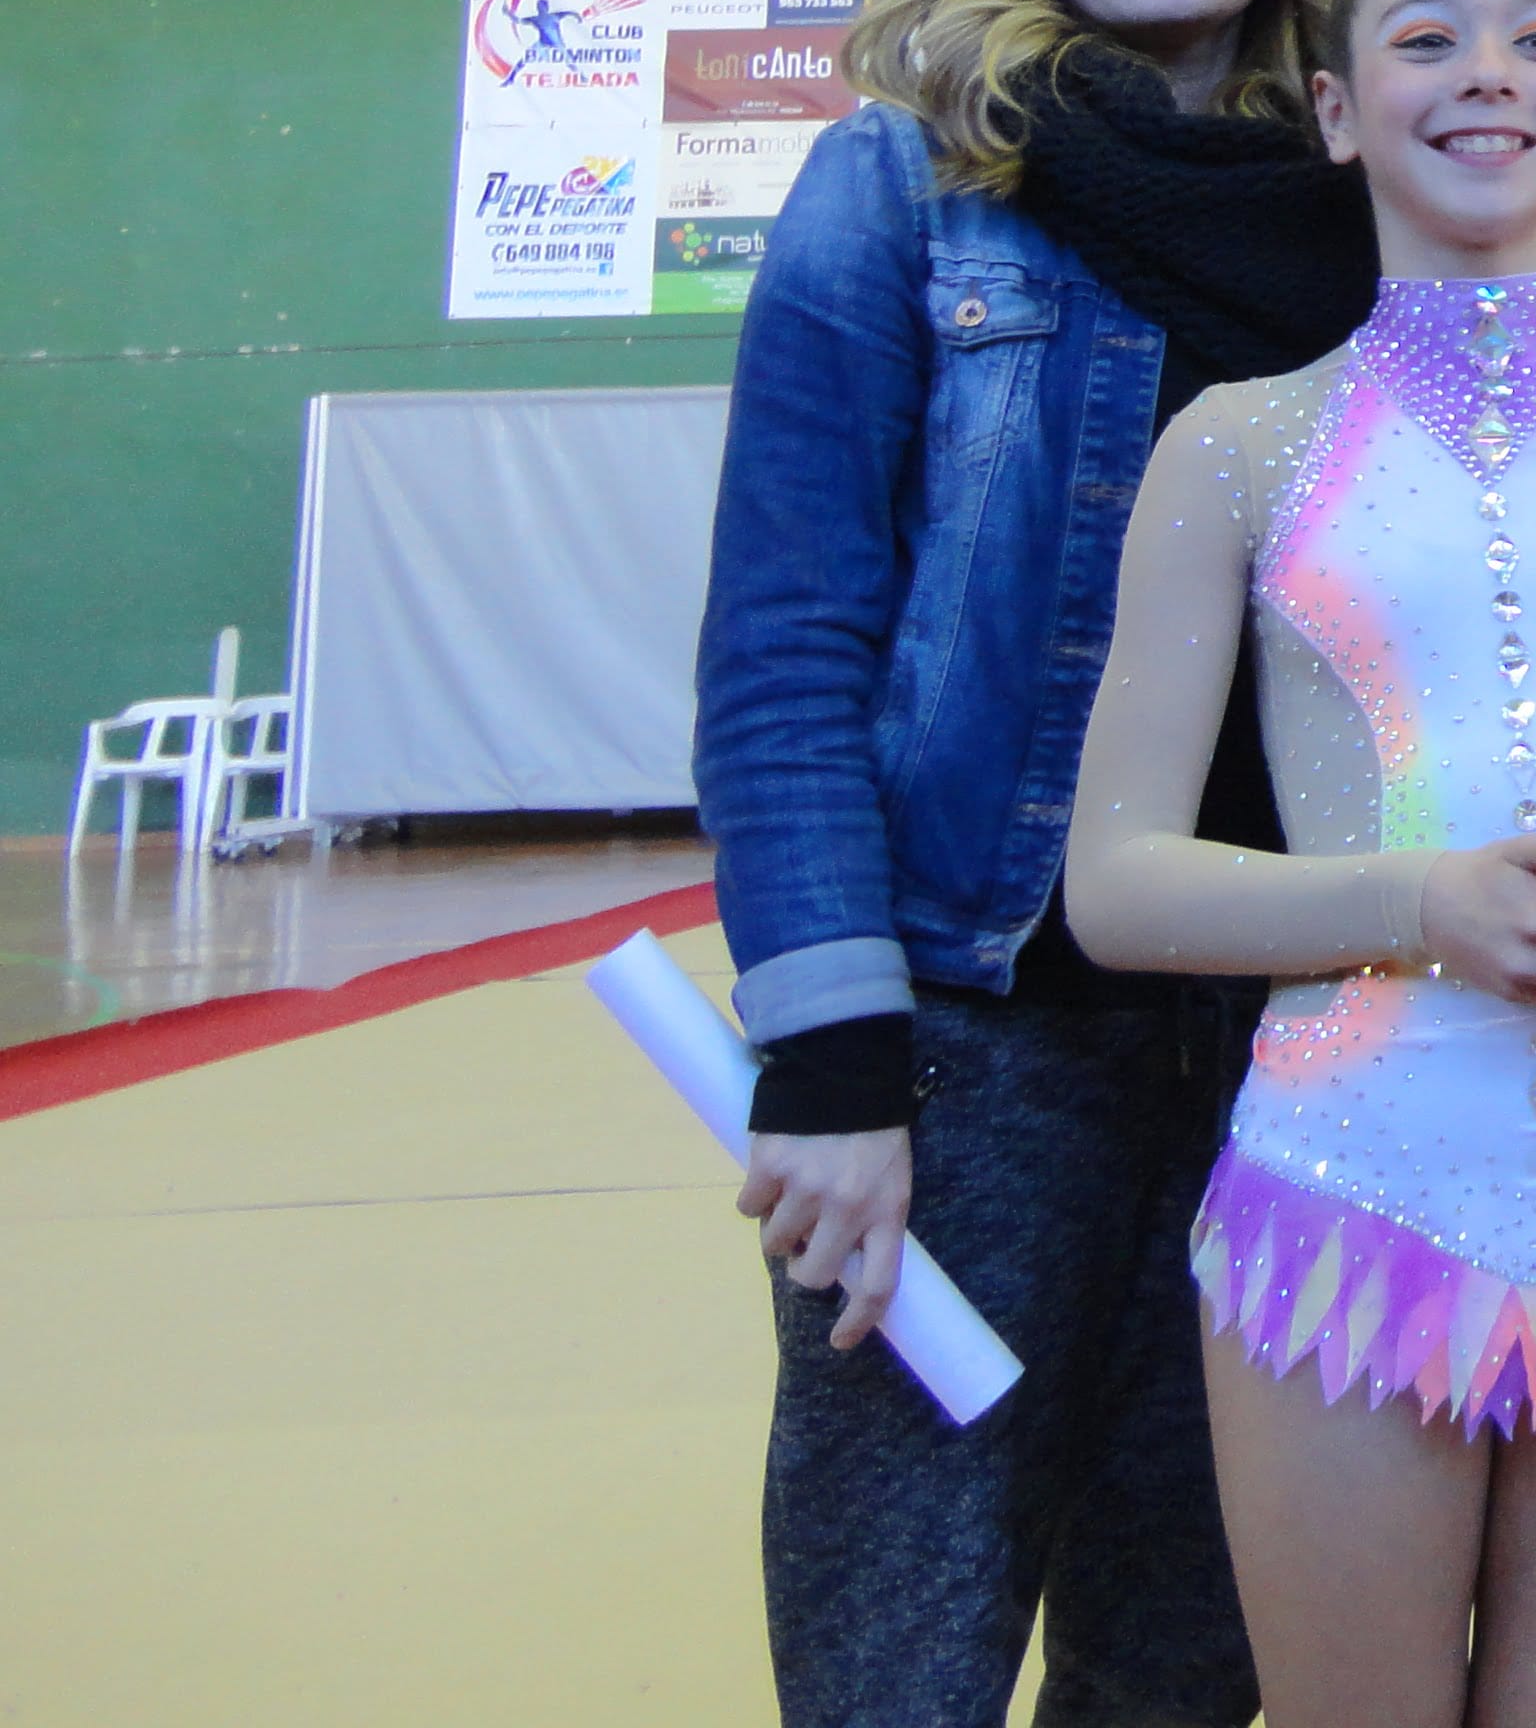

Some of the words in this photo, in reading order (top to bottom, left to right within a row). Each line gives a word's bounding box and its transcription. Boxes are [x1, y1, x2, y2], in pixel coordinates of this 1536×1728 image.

[671, 4, 764, 15] PEUGEOT
[592, 25, 643, 40] CLUB
[525, 48, 641, 63] BADMINTON
[475, 172, 556, 218] PEPE
[485, 224, 520, 237] CON
[524, 224, 544, 236] EL
[550, 222, 627, 236] DEPORTE
[506, 243, 542, 262] 649
